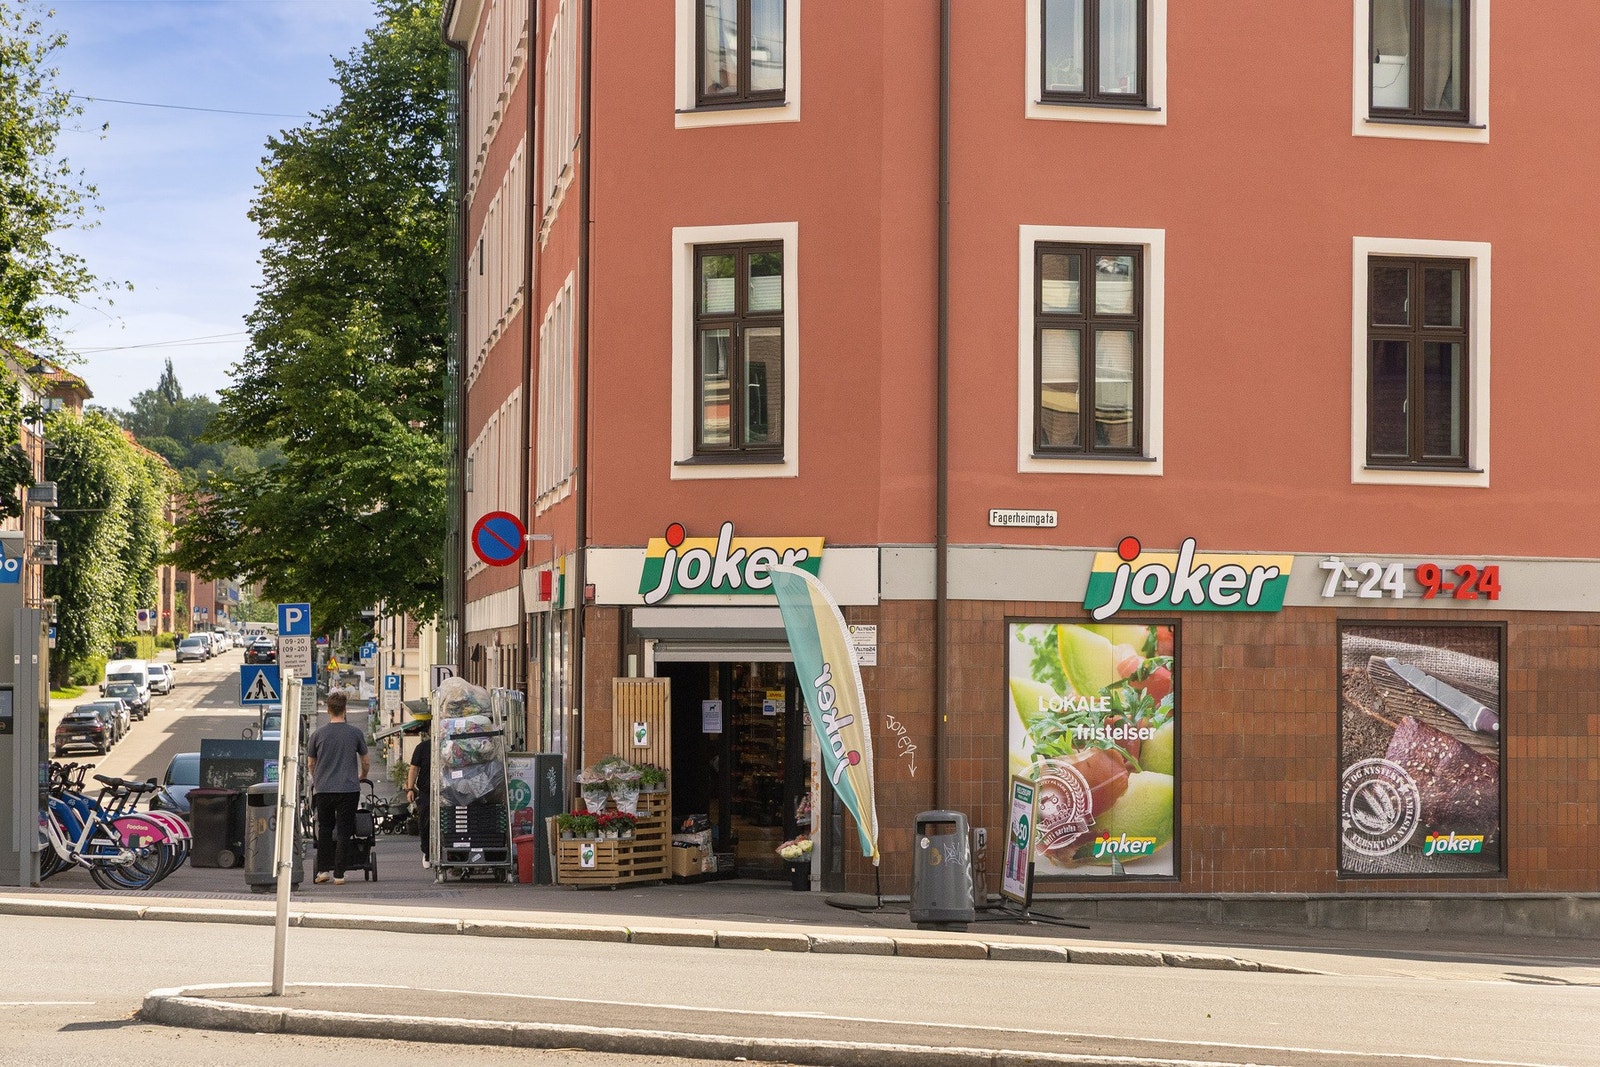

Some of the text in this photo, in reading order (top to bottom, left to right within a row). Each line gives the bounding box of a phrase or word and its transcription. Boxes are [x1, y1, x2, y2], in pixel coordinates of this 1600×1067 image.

[992, 511, 1054, 526] Fagerheimgata
[1091, 535, 1280, 622] joker
[1318, 556, 1501, 600] 7-24 9-24
[285, 608, 302, 632] P
[388, 677, 396, 688] P
[1038, 696, 1111, 712] LOKALE
[1077, 723, 1156, 740] fristelser
[126, 823, 149, 831] foodora
[1018, 823, 1028, 841] 50
[1095, 831, 1152, 858] joker
[1425, 831, 1480, 857] joker
